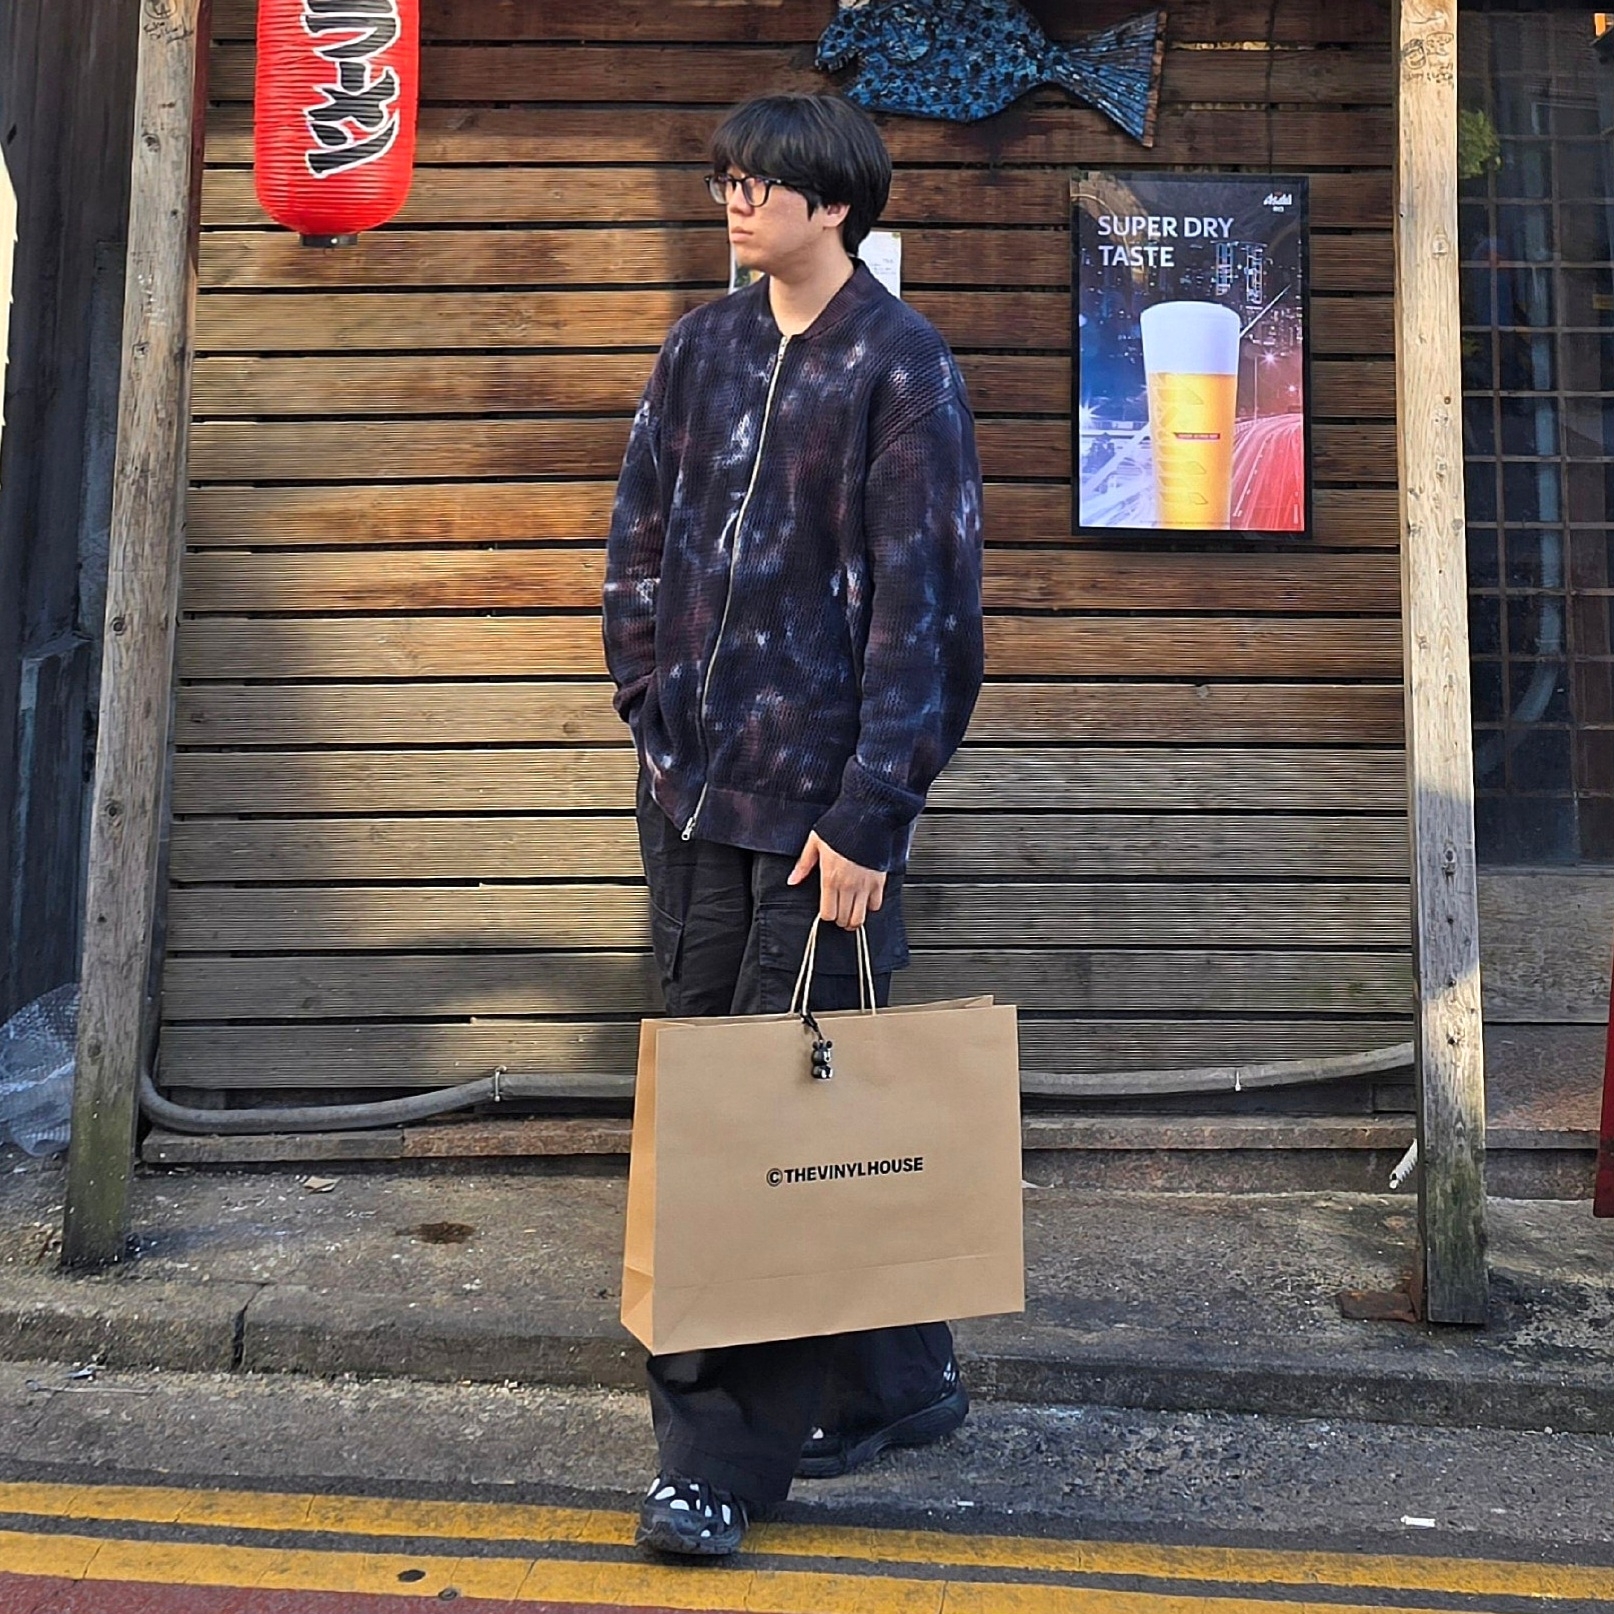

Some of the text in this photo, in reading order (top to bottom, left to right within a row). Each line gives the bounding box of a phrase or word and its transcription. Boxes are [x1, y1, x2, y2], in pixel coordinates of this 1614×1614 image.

[303, 0, 400, 178] ラーメン
[1098, 215, 1235, 239] SUPER DRY
[1098, 245, 1175, 267] TASTE
